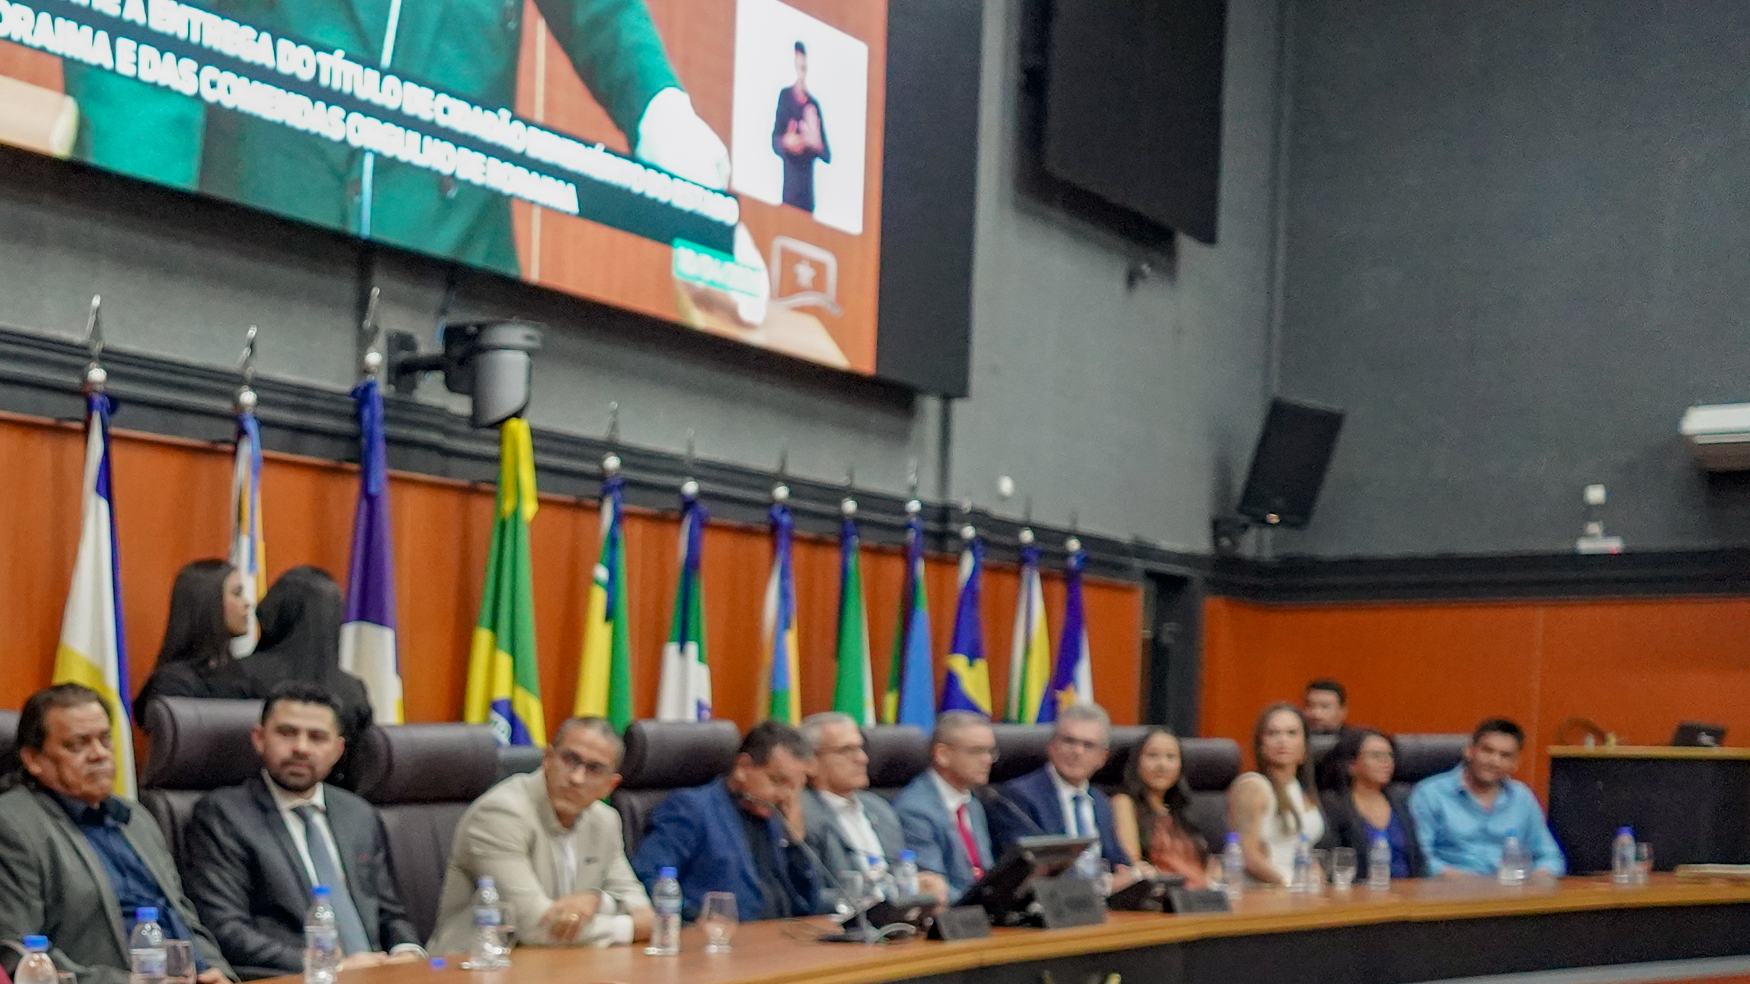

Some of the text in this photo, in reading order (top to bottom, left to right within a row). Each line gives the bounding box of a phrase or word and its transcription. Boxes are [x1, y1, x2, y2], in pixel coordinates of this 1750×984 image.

[115, 36, 138, 78] E
[137, 44, 200, 96] DAS
[121, 0, 147, 27] A
[147, 0, 277, 70] ENTREGA
[276, 38, 317, 82] DO
[315, 49, 403, 111] TÍTULO
